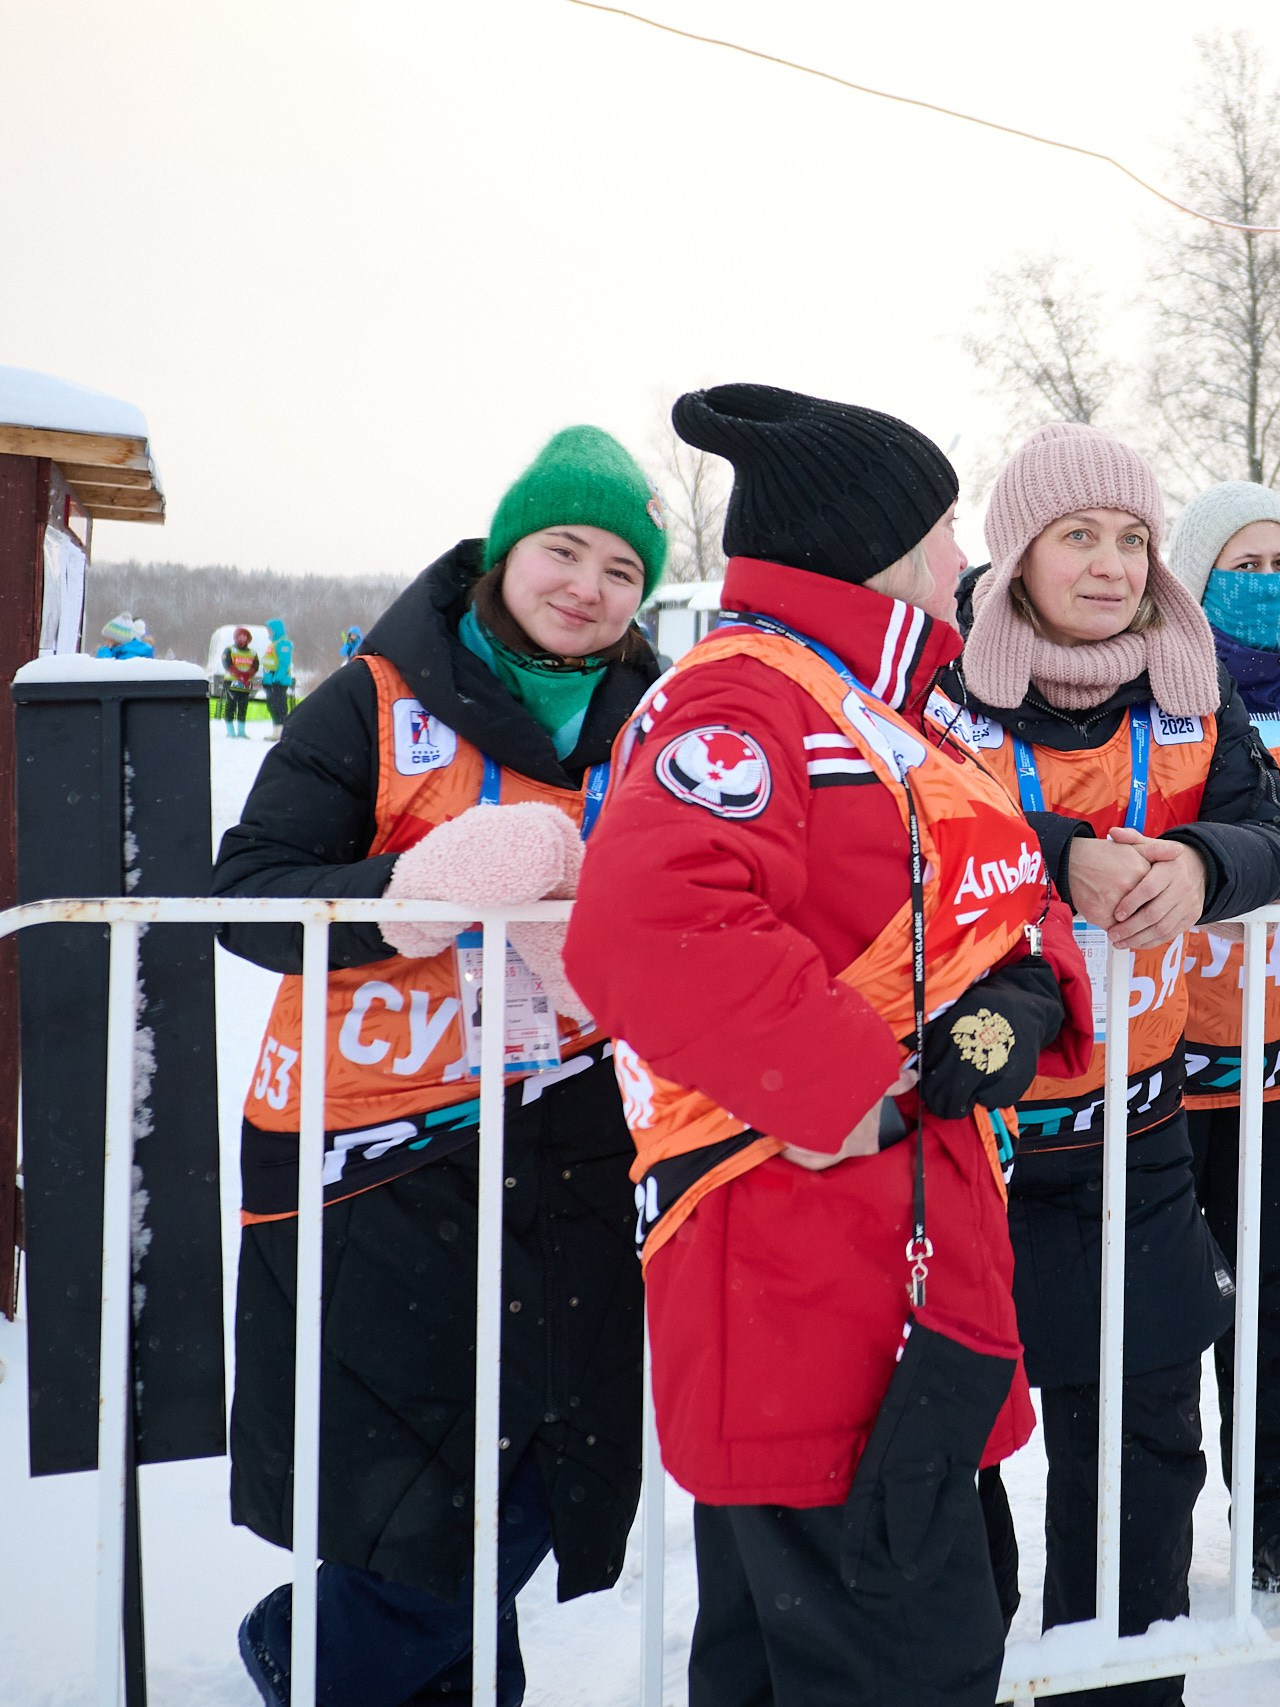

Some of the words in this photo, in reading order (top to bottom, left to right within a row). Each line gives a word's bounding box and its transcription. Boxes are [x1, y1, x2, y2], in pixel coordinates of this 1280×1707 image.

[1160, 718, 1195, 735] 2025
[412, 754, 441, 764] СБР
[910, 814, 920, 855] CLASSIC
[912, 855, 921, 884] MODA
[953, 841, 1042, 905] Альфа
[914, 911, 924, 953] CLASSIC
[915, 953, 924, 983] MODA
[338, 980, 469, 1083] СУ
[253, 1036, 299, 1111] 53
